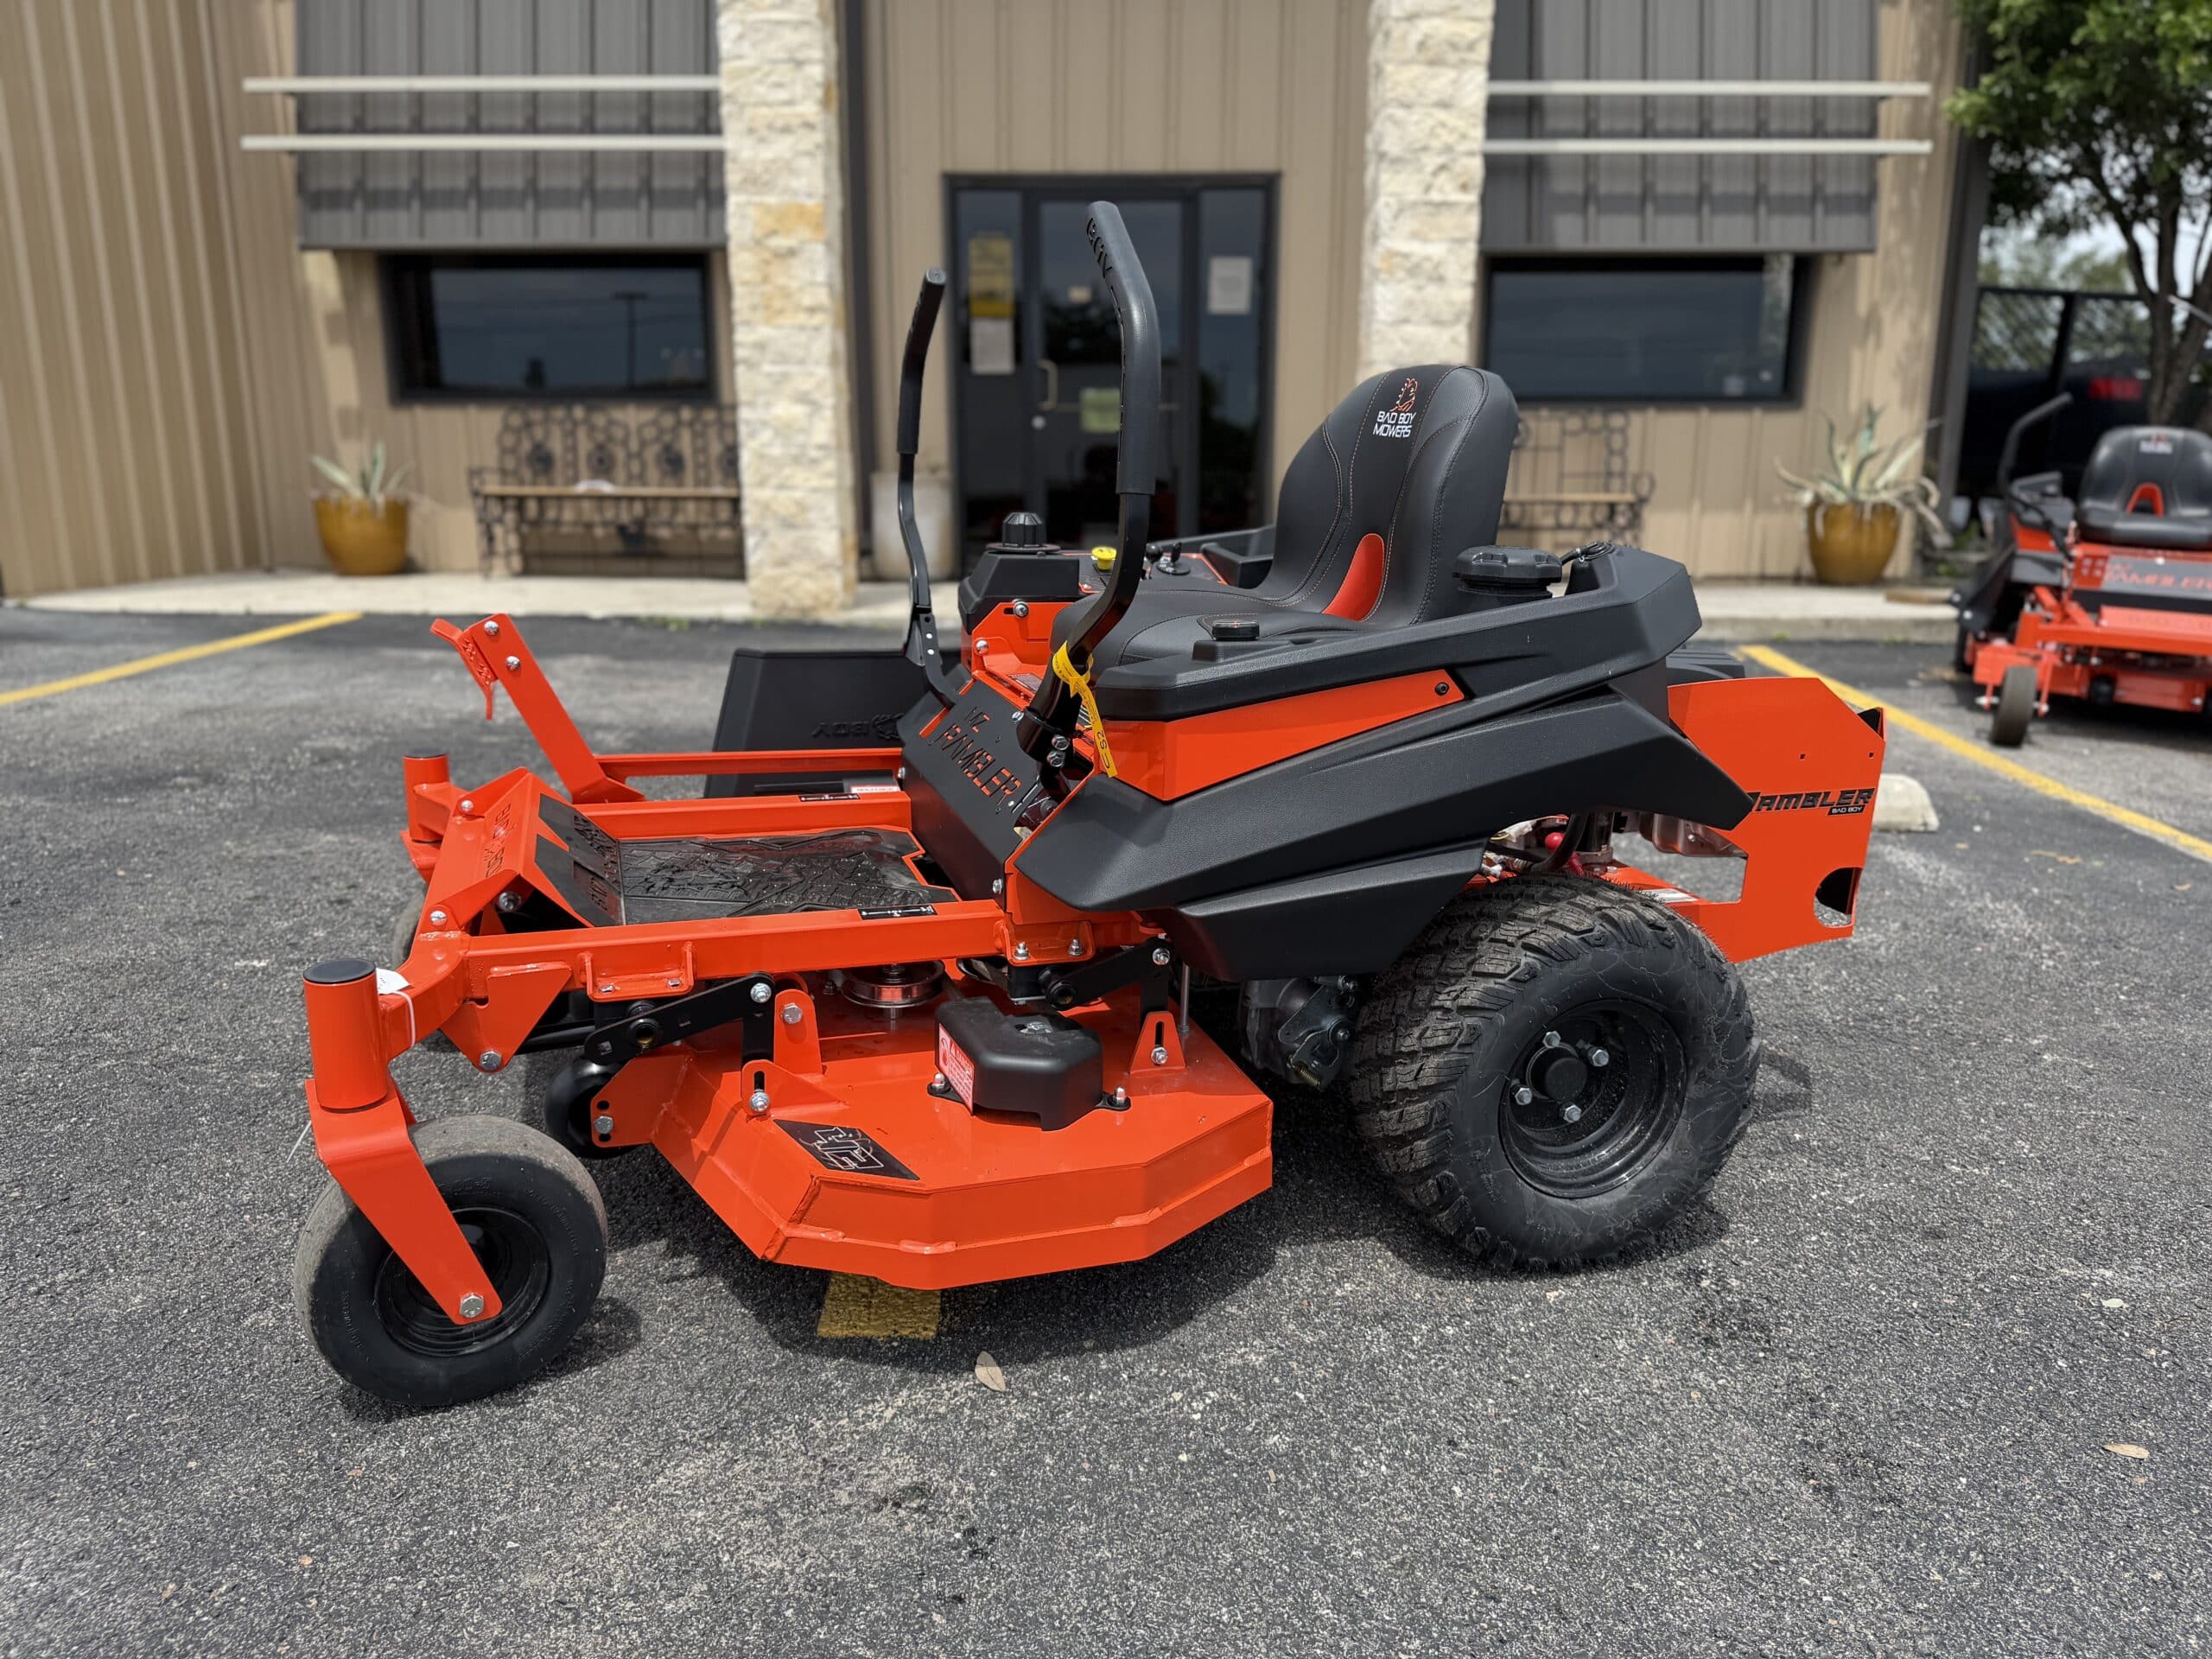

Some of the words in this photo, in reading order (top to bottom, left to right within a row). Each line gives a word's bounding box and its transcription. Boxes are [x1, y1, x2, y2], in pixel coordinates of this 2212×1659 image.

[1376, 410, 1398, 423] BAD
[1398, 411, 1417, 425] BOY
[1372, 423, 1413, 439] MOWERS
[934, 722, 1023, 806] RAMBLER
